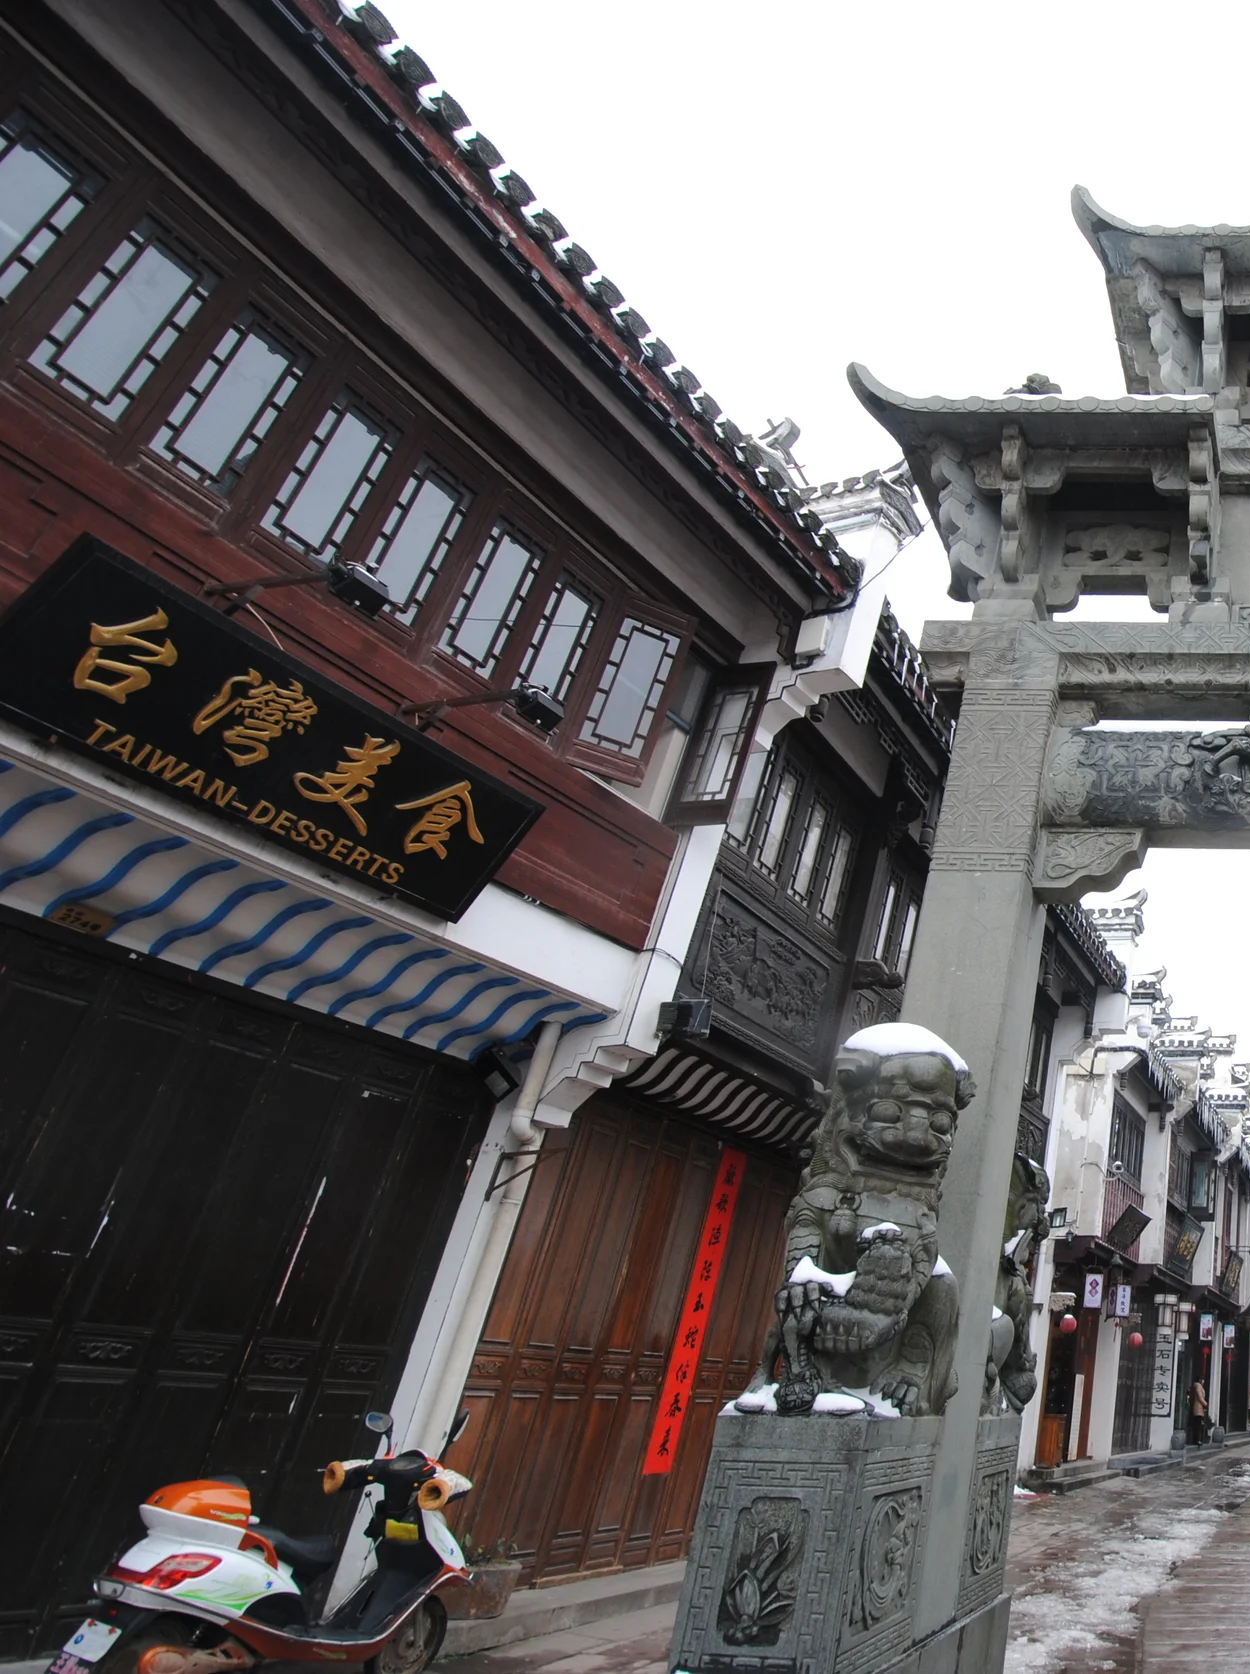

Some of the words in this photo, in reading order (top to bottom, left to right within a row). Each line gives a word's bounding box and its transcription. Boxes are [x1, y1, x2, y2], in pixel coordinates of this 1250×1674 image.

[73, 606, 485, 860] 台灣美食
[85, 718, 405, 886] TAIWAN-DESSERTS
